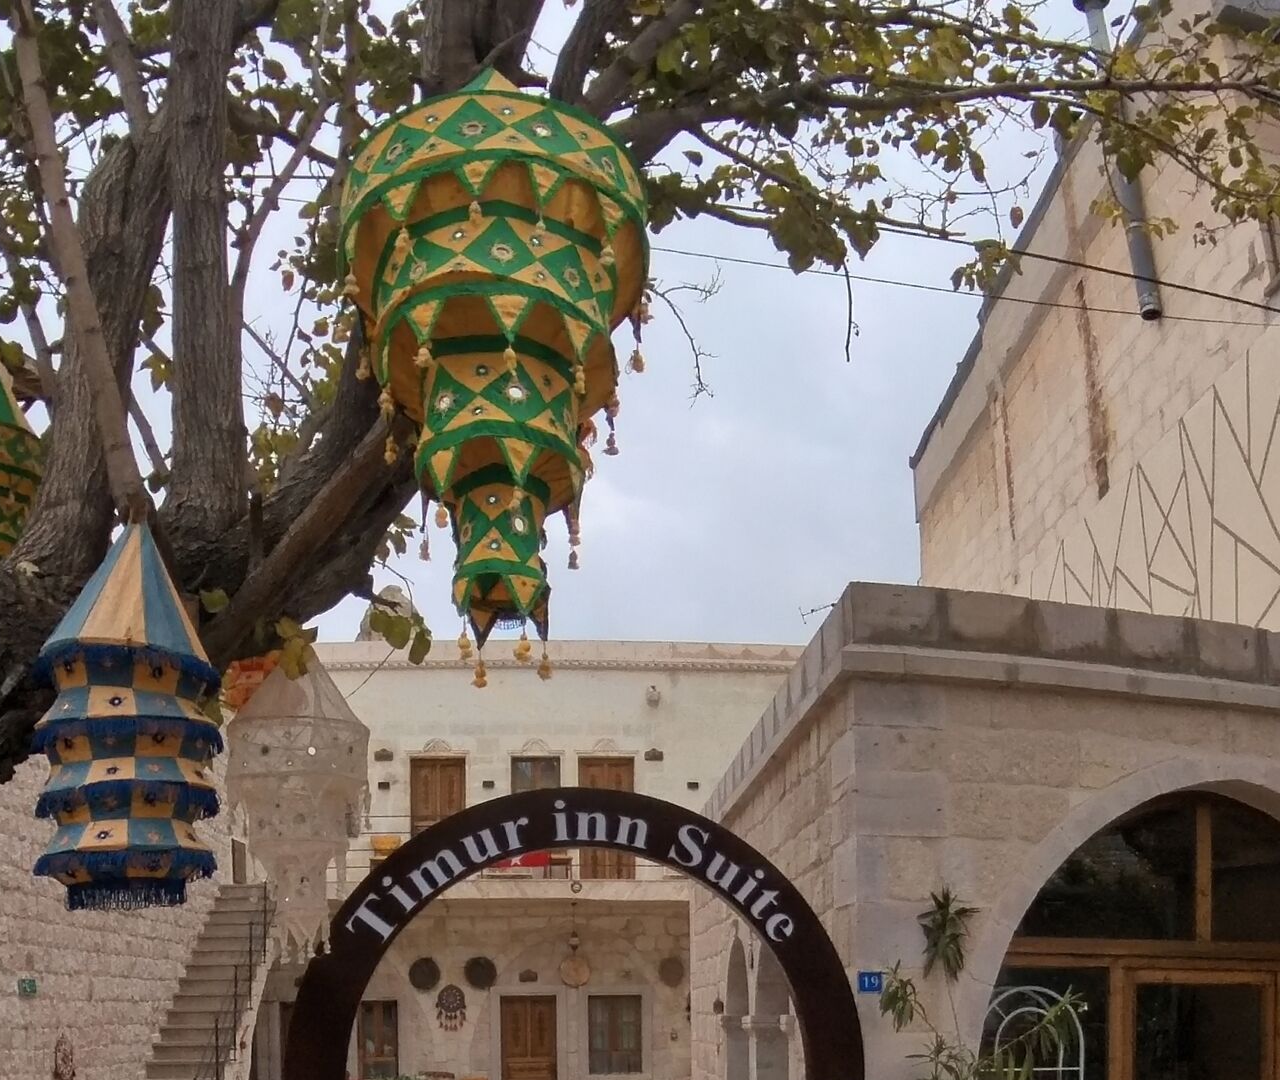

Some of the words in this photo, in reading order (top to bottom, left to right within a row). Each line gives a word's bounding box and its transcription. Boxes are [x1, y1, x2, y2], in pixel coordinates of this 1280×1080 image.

[345, 816, 529, 944] Timur
[552, 800, 648, 849] inn
[668, 825, 794, 942] Suite
[863, 975, 879, 988] 19
